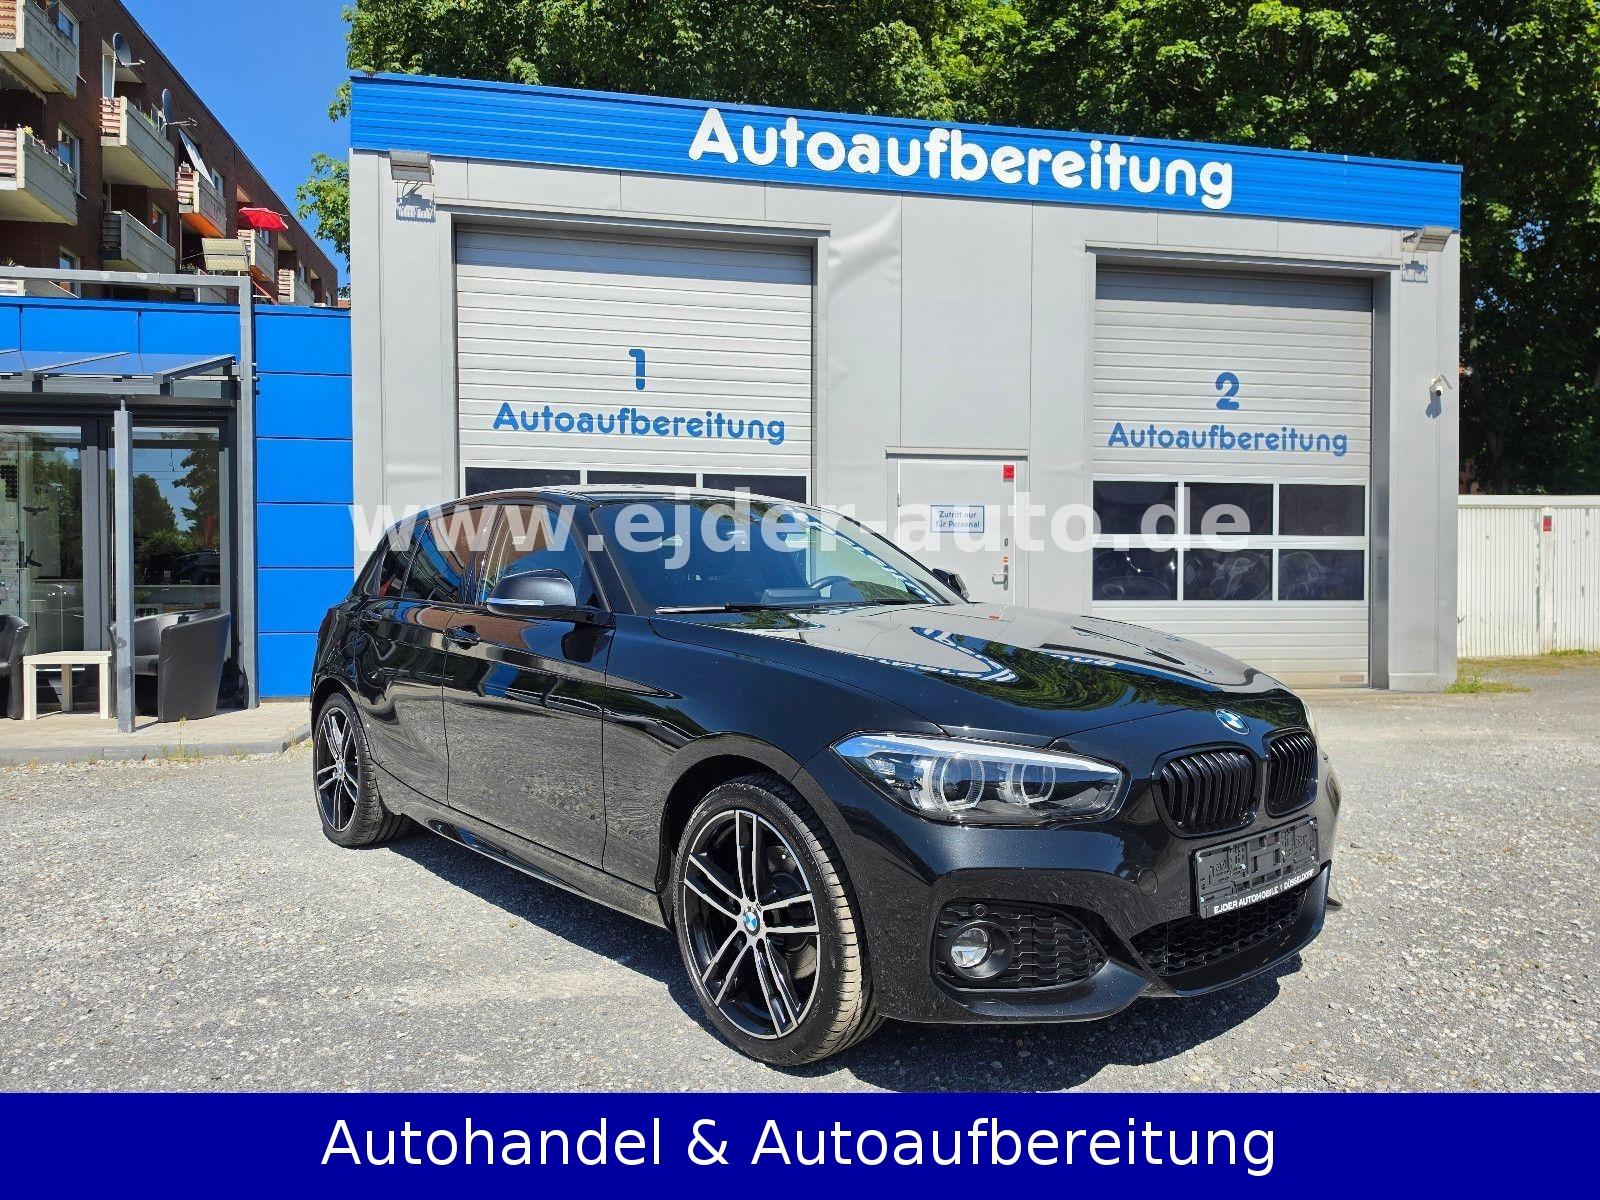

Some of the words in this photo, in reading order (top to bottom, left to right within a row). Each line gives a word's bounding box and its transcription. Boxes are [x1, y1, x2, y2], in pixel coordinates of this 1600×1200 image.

[688, 107, 1233, 210] Autoaufbereitung
[629, 348, 646, 391] 1
[1215, 372, 1241, 411] 2
[492, 402, 786, 446] Autoaufbereitung
[1107, 422, 1348, 458] Autoaufbereitung
[939, 510, 962, 519] Zutritt
[948, 520, 980, 529] Personal
[1213, 900, 1238, 915] EJDER
[1238, 886, 1279, 908] AUTOMOBILE
[1283, 868, 1315, 890] DÜSSELDORF
